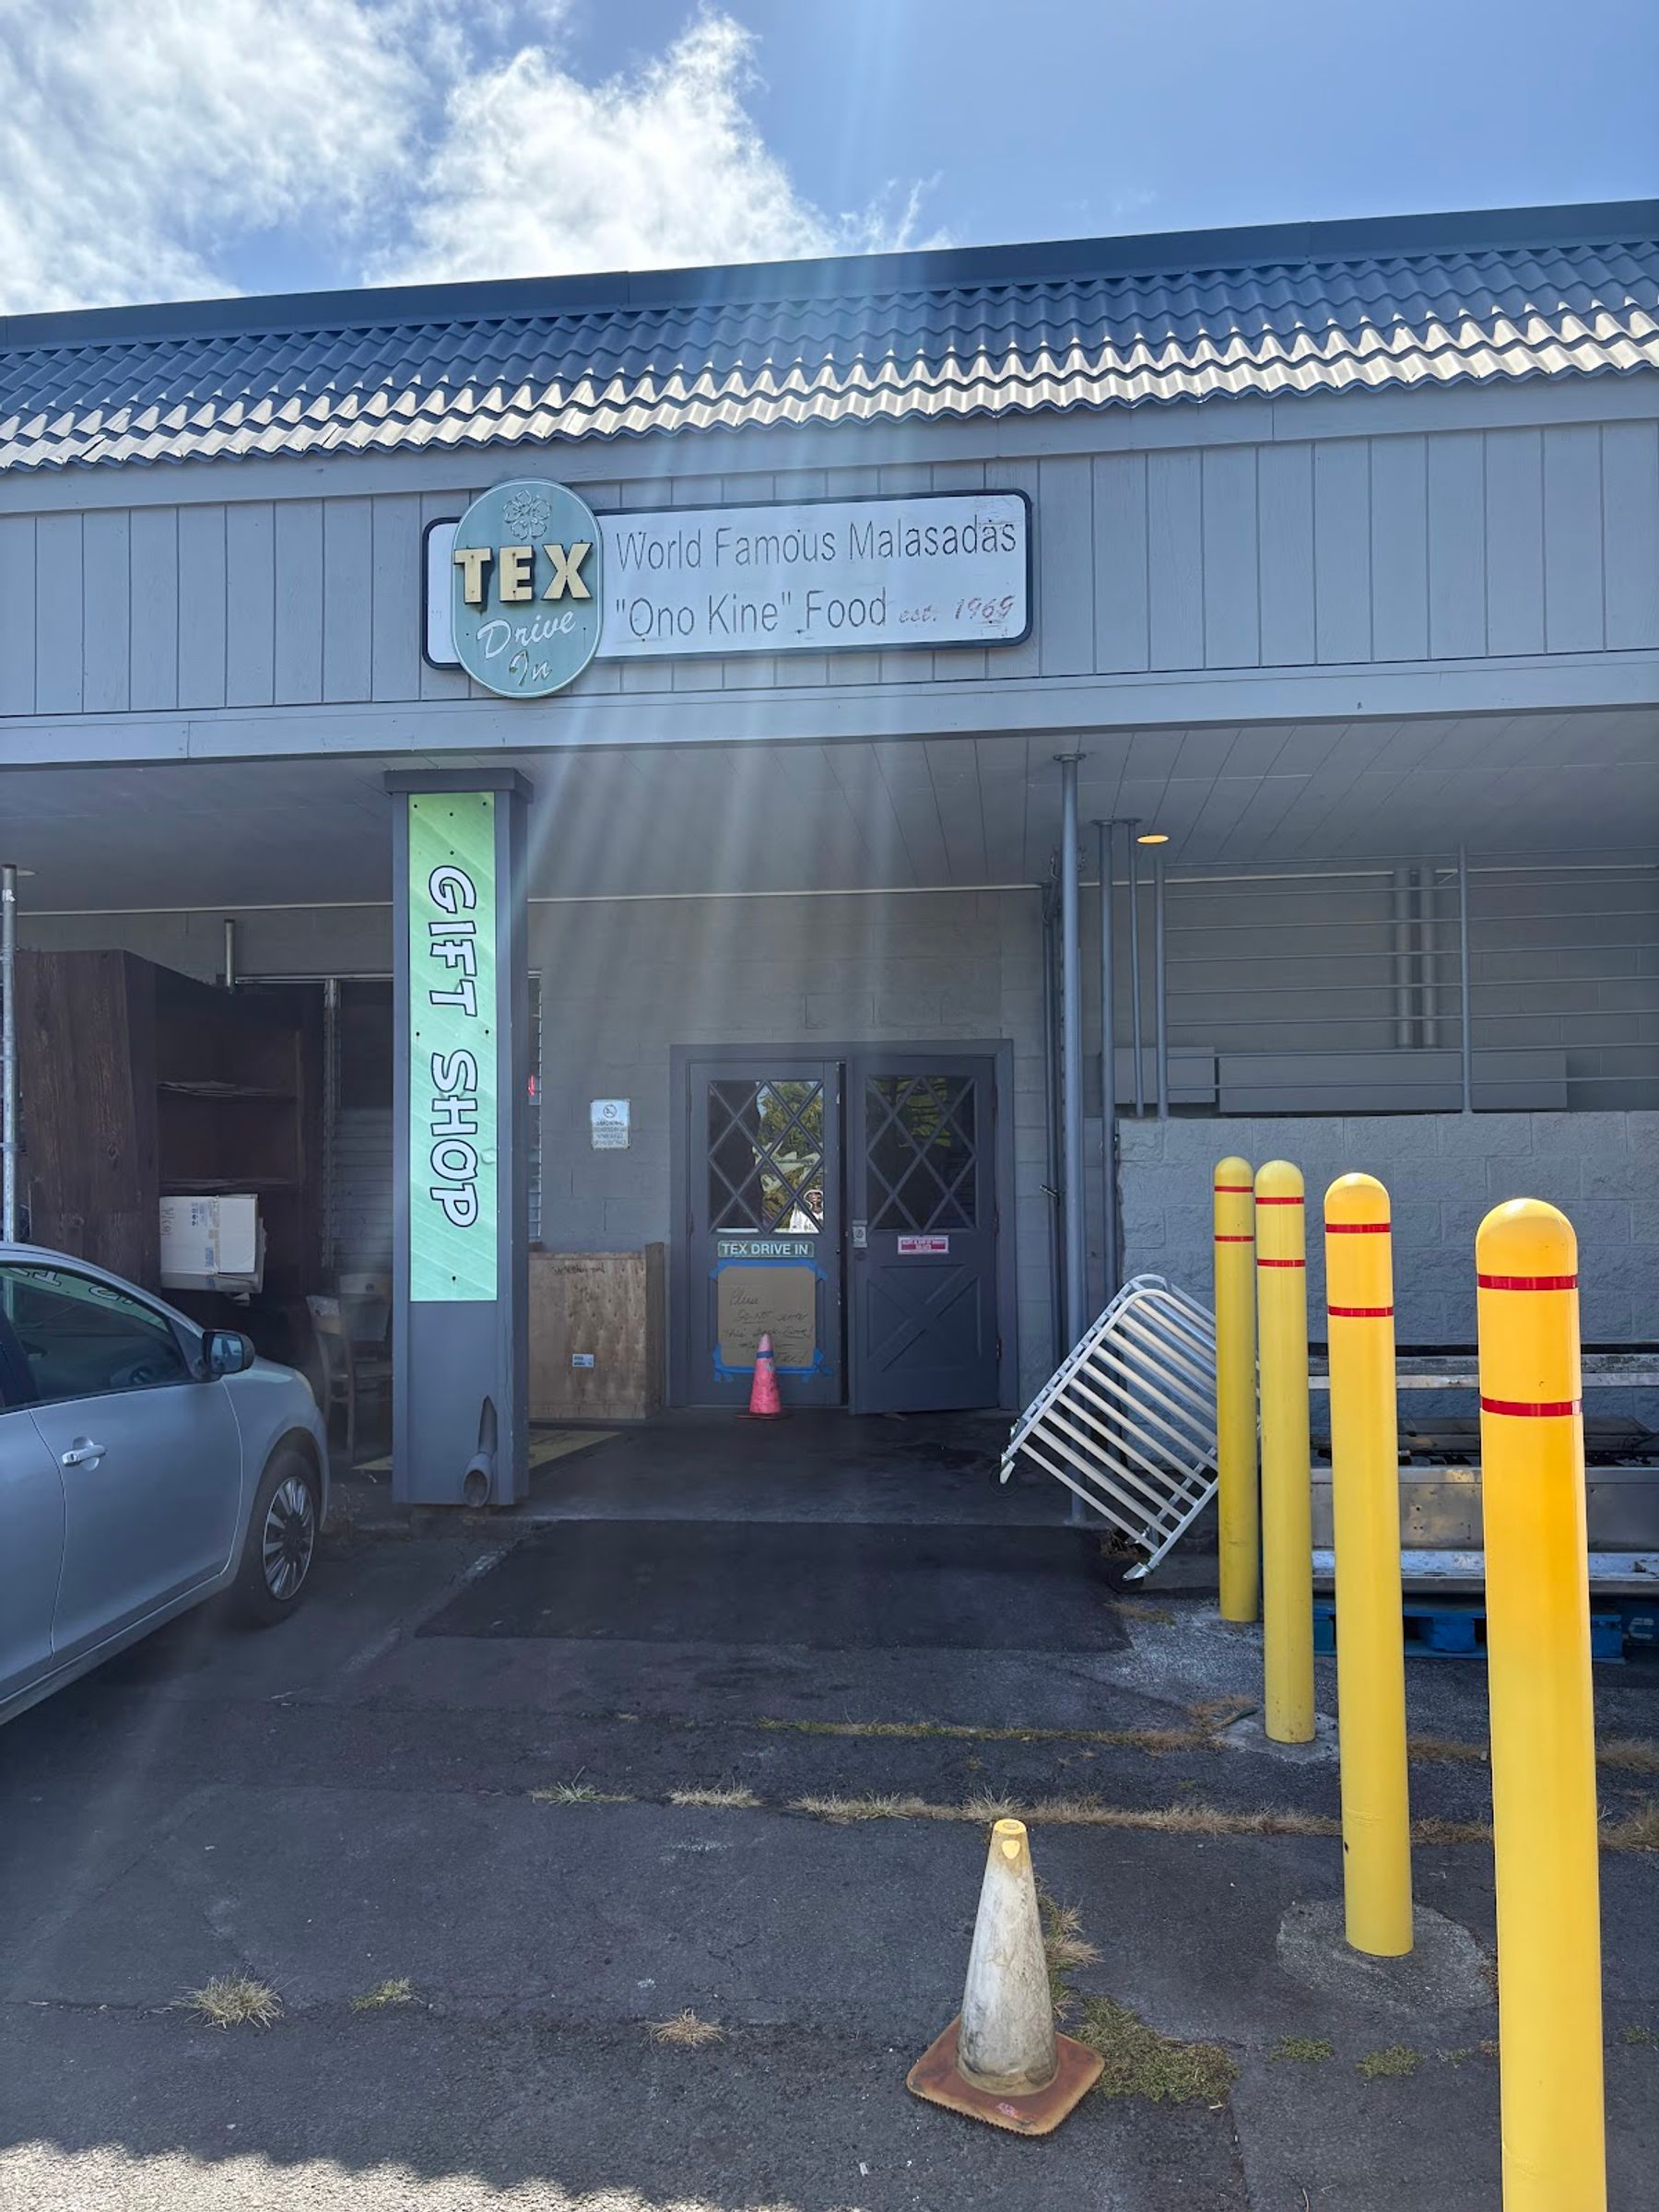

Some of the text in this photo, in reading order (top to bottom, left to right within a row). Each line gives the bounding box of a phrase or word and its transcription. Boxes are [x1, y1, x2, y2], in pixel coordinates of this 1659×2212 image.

[617, 513, 1016, 571] World Famous Malasadas
[453, 543, 594, 603] TEX
[477, 610, 576, 660] Drive
[616, 597, 695, 637] "Ono
[708, 591, 792, 635] Kine"
[805, 587, 887, 629] Food
[955, 595, 1017, 619] 1969
[509, 649, 552, 687] In
[429, 865, 478, 1228] GIFT SHOP
[722, 1243, 808, 1254] TEX DRIVE IN
